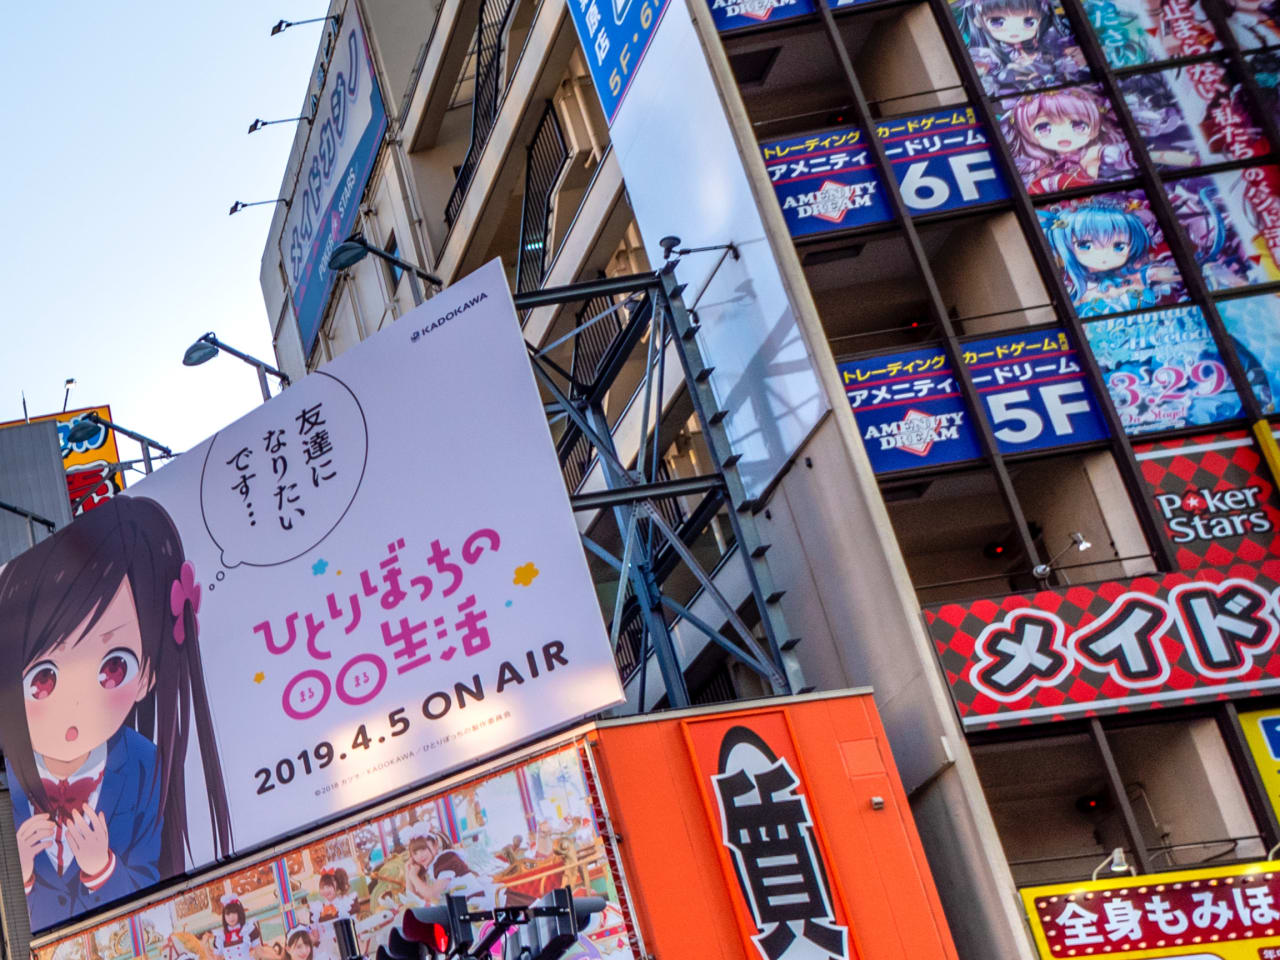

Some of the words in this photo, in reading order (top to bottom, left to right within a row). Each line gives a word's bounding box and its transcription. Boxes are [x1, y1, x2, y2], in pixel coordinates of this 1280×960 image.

[899, 152, 996, 210] 6F
[421, 291, 488, 337] KADOKAWA
[294, 401, 338, 488] 友達に
[986, 381, 1091, 444] 5F
[262, 428, 306, 532] なりたい
[1168, 511, 1272, 544] Stars
[253, 527, 502, 662] ひとりぼっちの
[254, 707, 411, 796] 2019.4.5
[421, 672, 486, 722] ON
[495, 638, 570, 693] AIR
